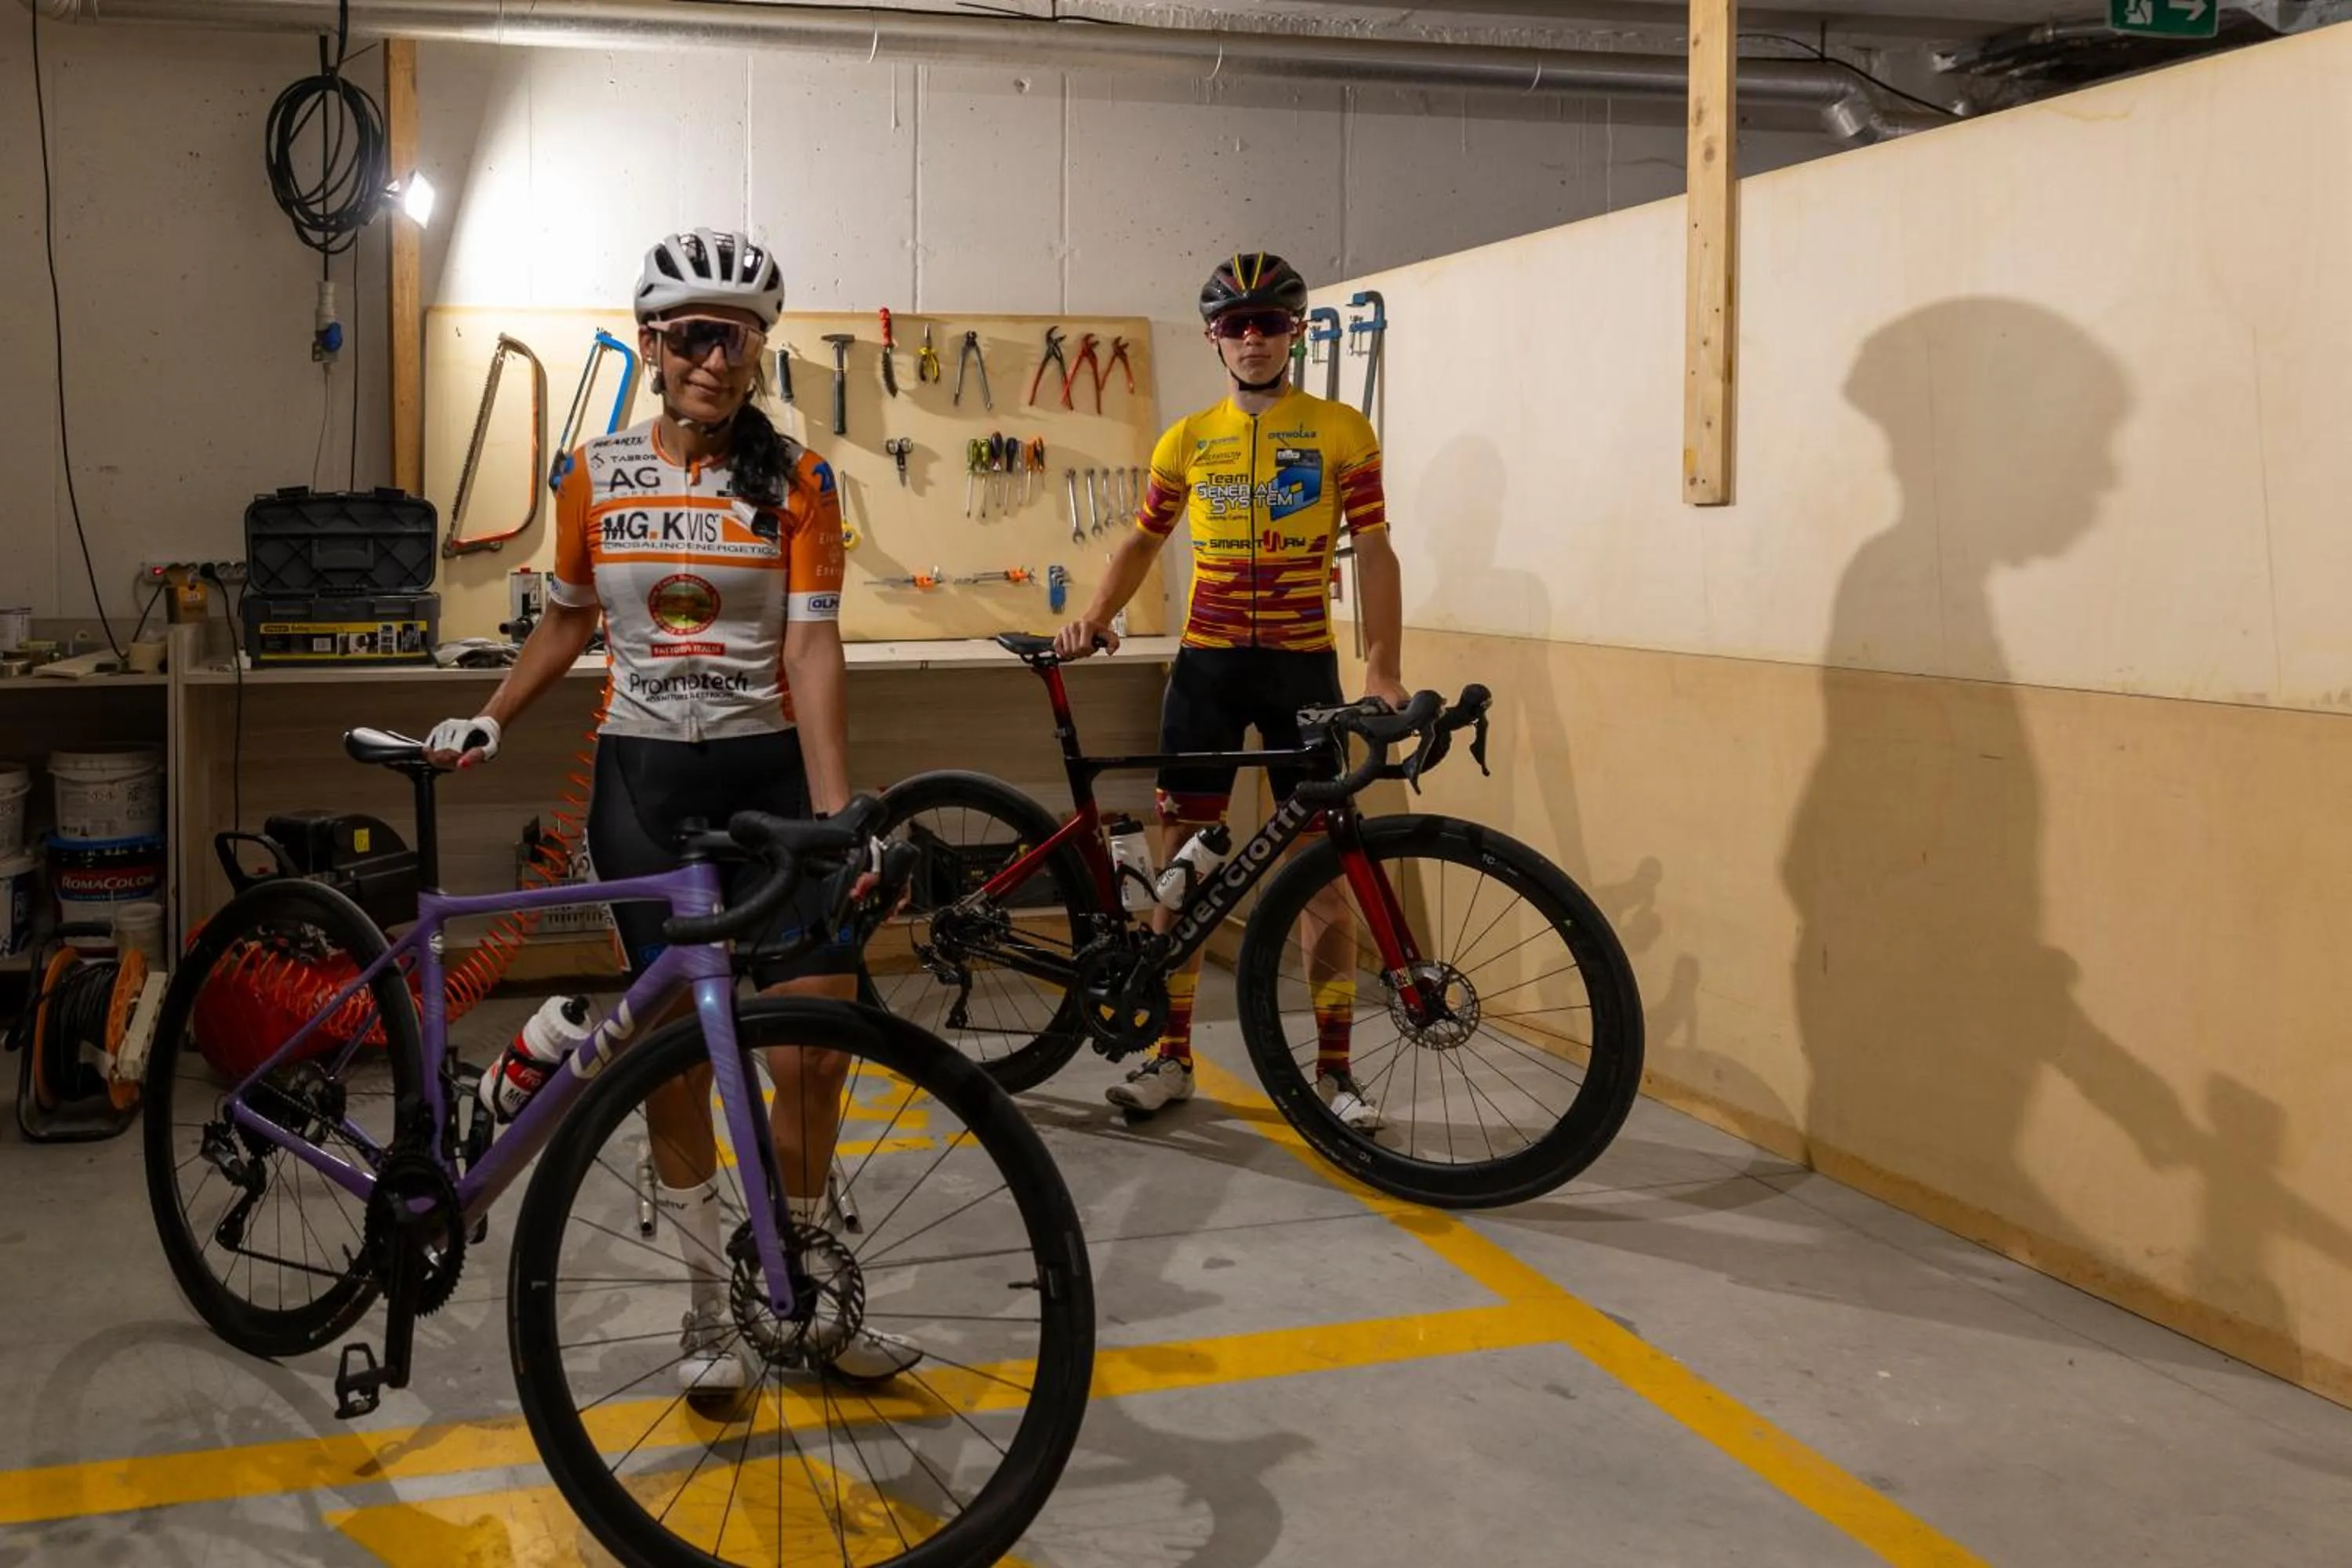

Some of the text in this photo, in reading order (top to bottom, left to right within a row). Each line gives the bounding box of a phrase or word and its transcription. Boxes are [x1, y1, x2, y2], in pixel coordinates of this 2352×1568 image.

[609, 466, 661, 492] AG
[1207, 473, 1249, 485] Team
[1195, 481, 1279, 499] GENERAL
[1211, 494, 1293, 514] SYSTEM
[630, 672, 748, 695] Promotech
